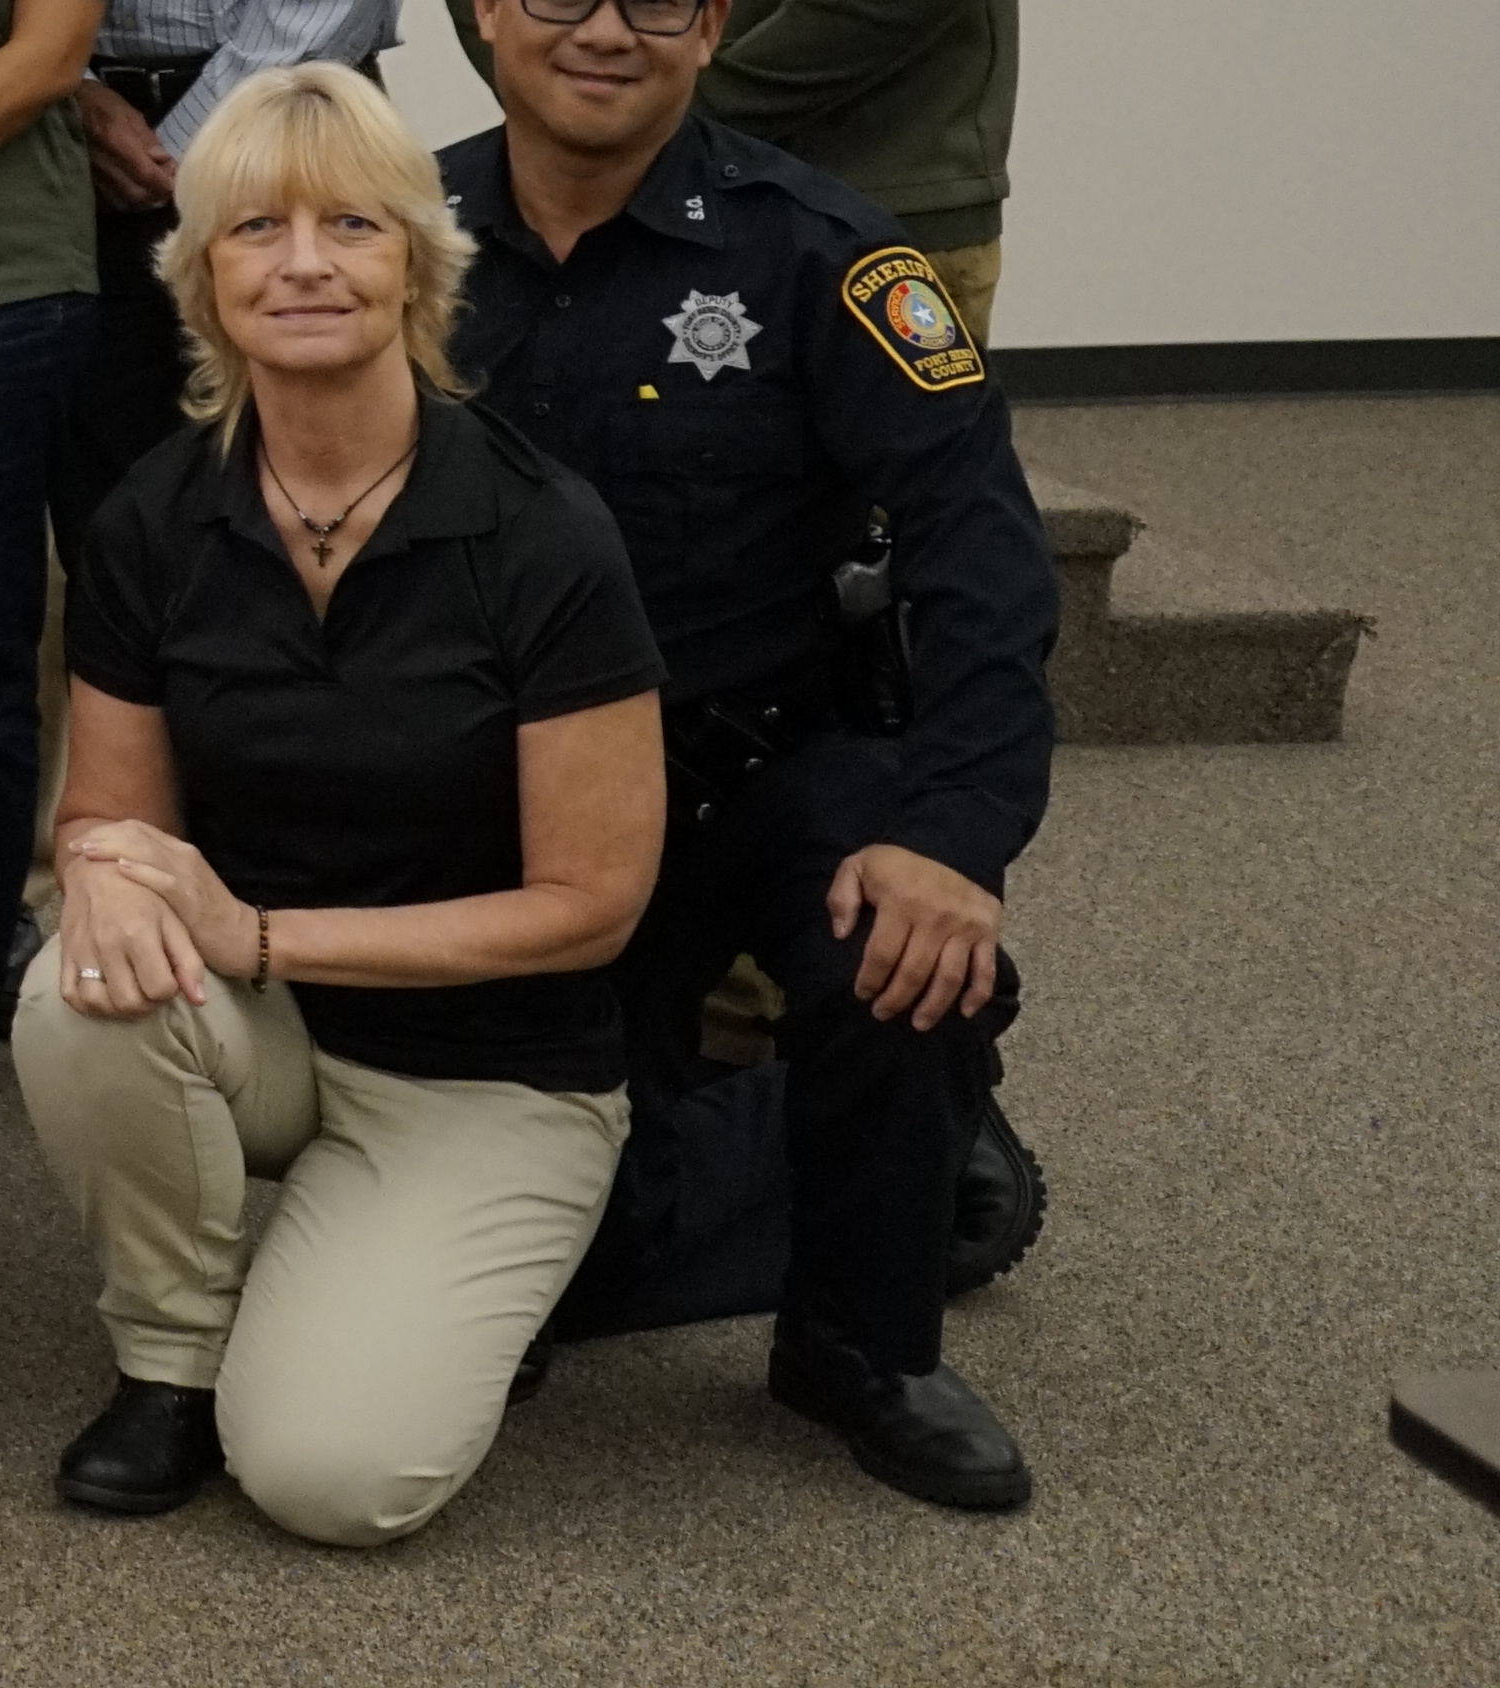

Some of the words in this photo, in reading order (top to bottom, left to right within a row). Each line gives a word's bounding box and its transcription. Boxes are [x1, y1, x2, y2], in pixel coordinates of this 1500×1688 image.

[852, 259, 934, 303] SHERIFF
[695, 296, 733, 309] DEPUTY
[914, 352, 948, 372] FORT
[931, 360, 976, 379] COUNTY
